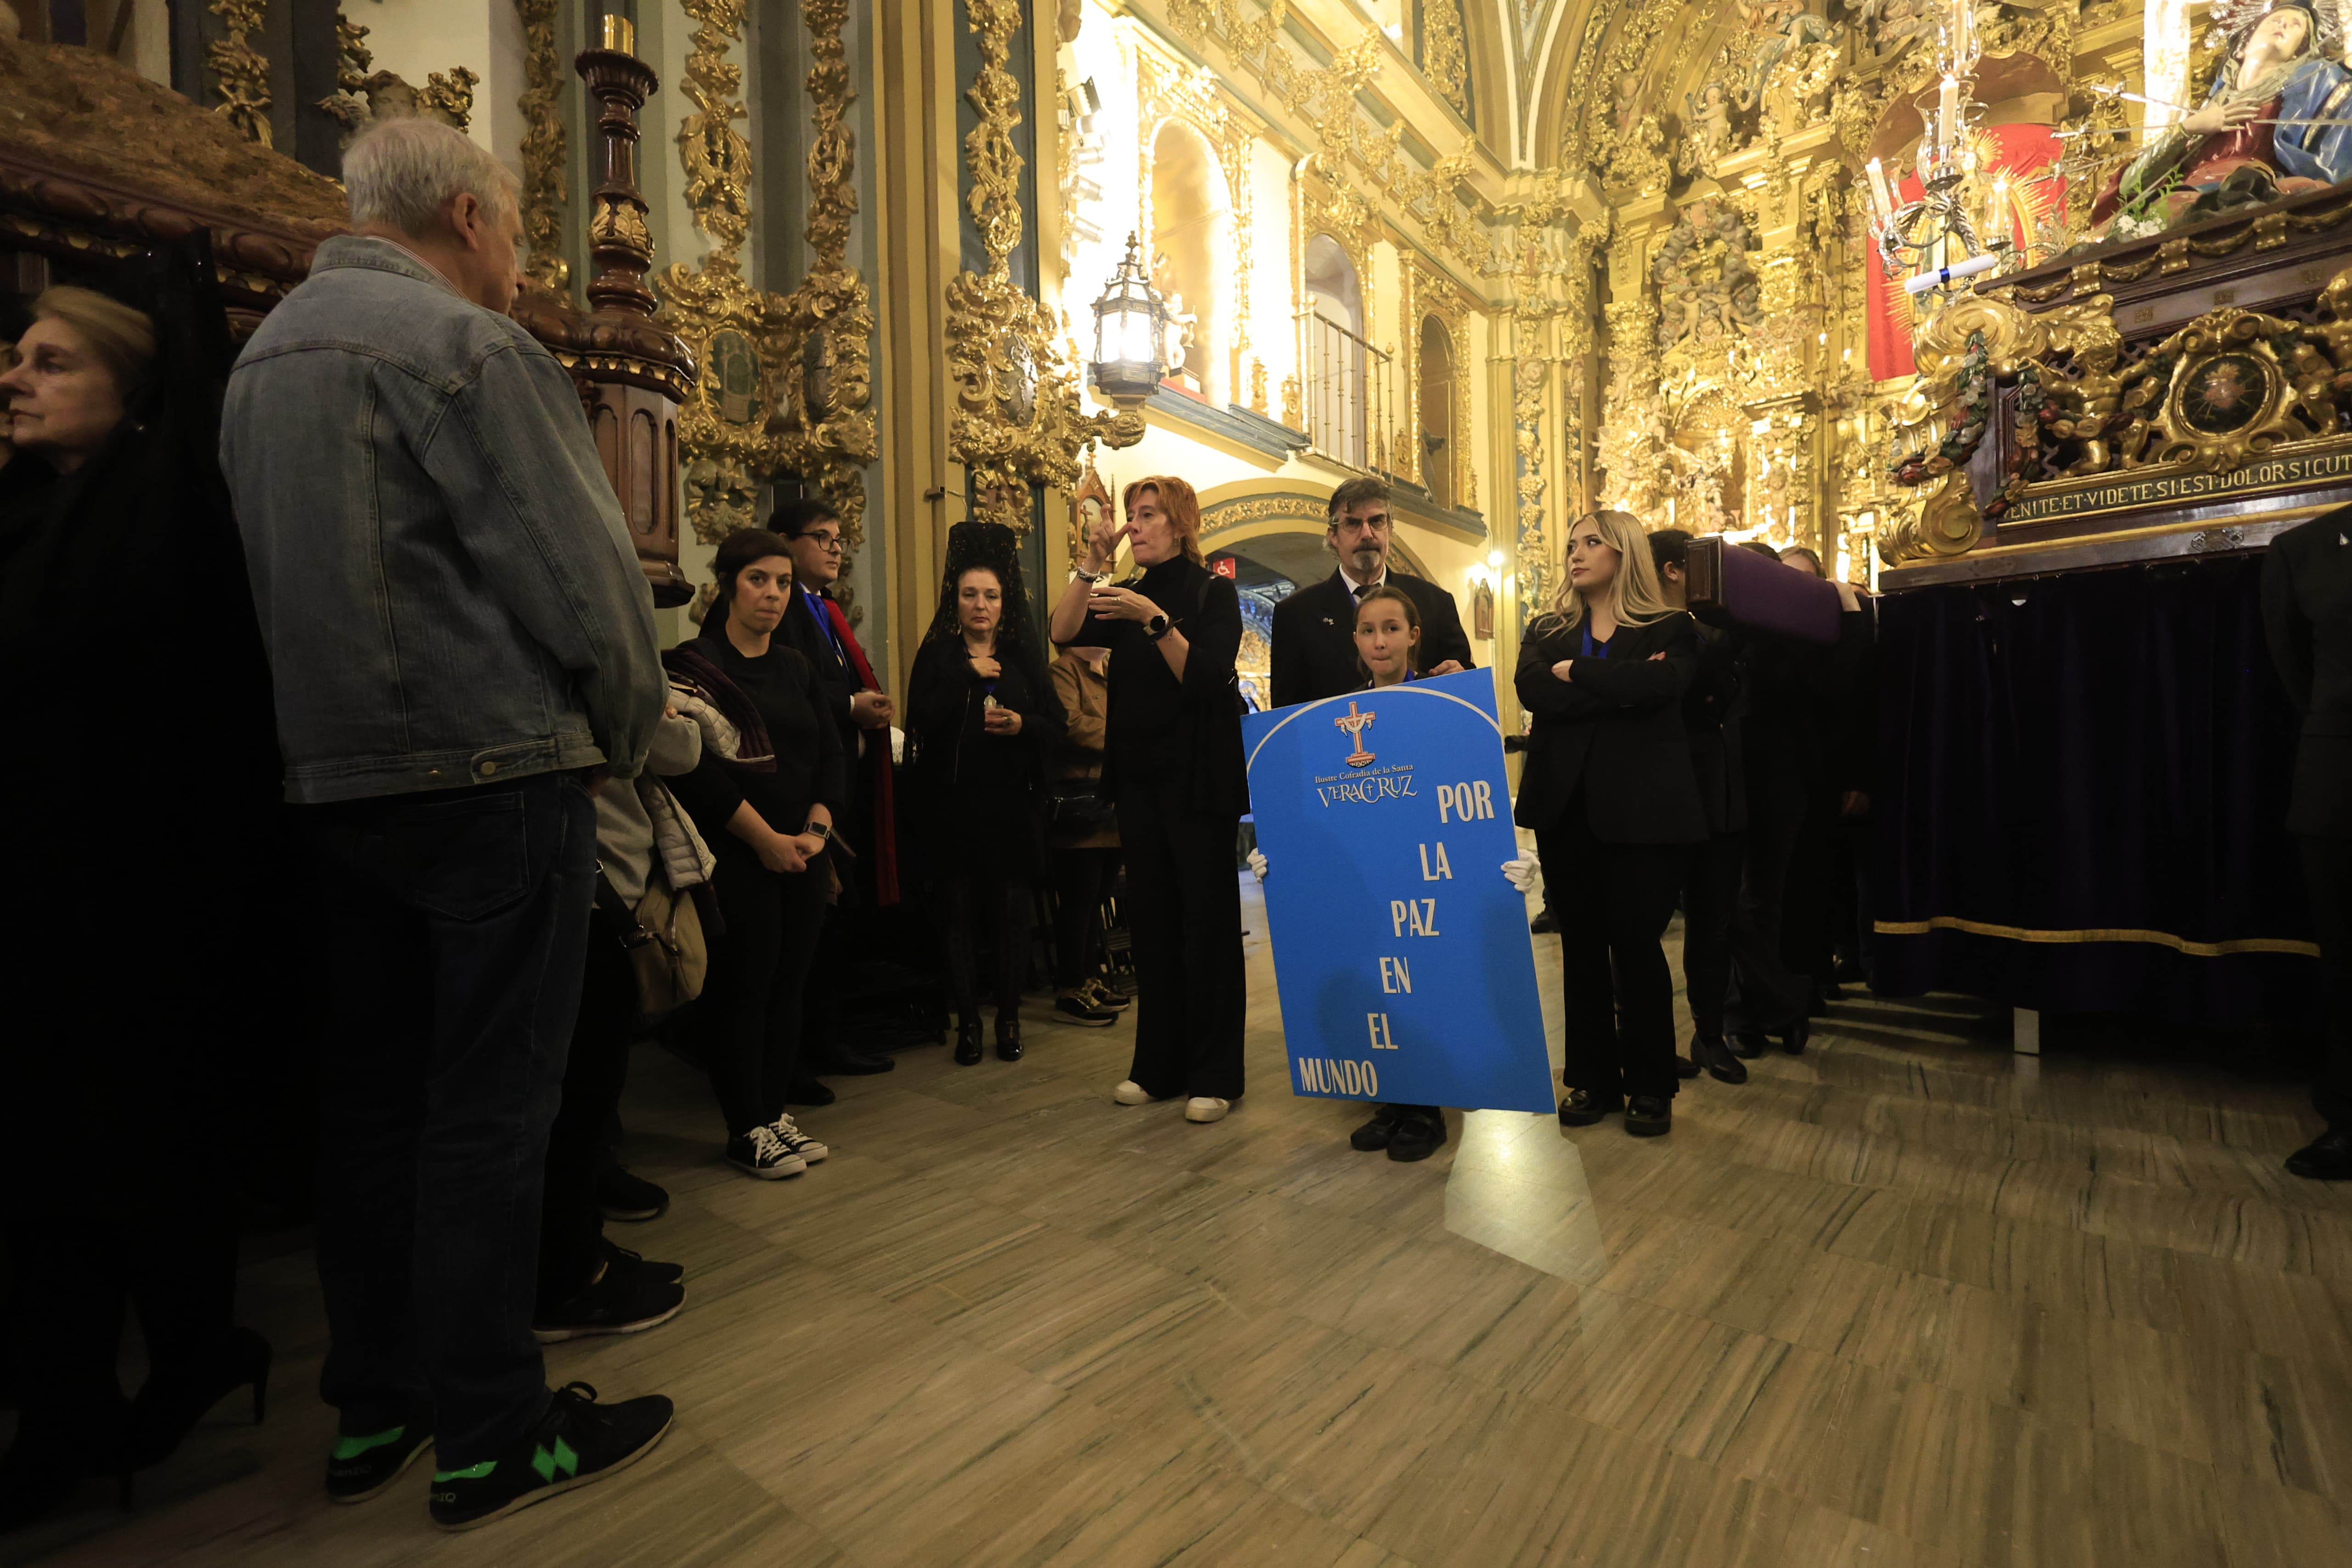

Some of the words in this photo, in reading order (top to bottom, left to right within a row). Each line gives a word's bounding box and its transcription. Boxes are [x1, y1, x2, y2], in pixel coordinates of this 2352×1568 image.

[1339, 770, 1371, 780] Cofradía
[1437, 780, 1495, 823] POR
[1419, 842, 1453, 881] LA
[1391, 898, 1440, 937] PAZ
[1379, 957, 1412, 993] EN
[1367, 1013, 1398, 1049] EL
[1299, 1057, 1378, 1097] MUNDO
